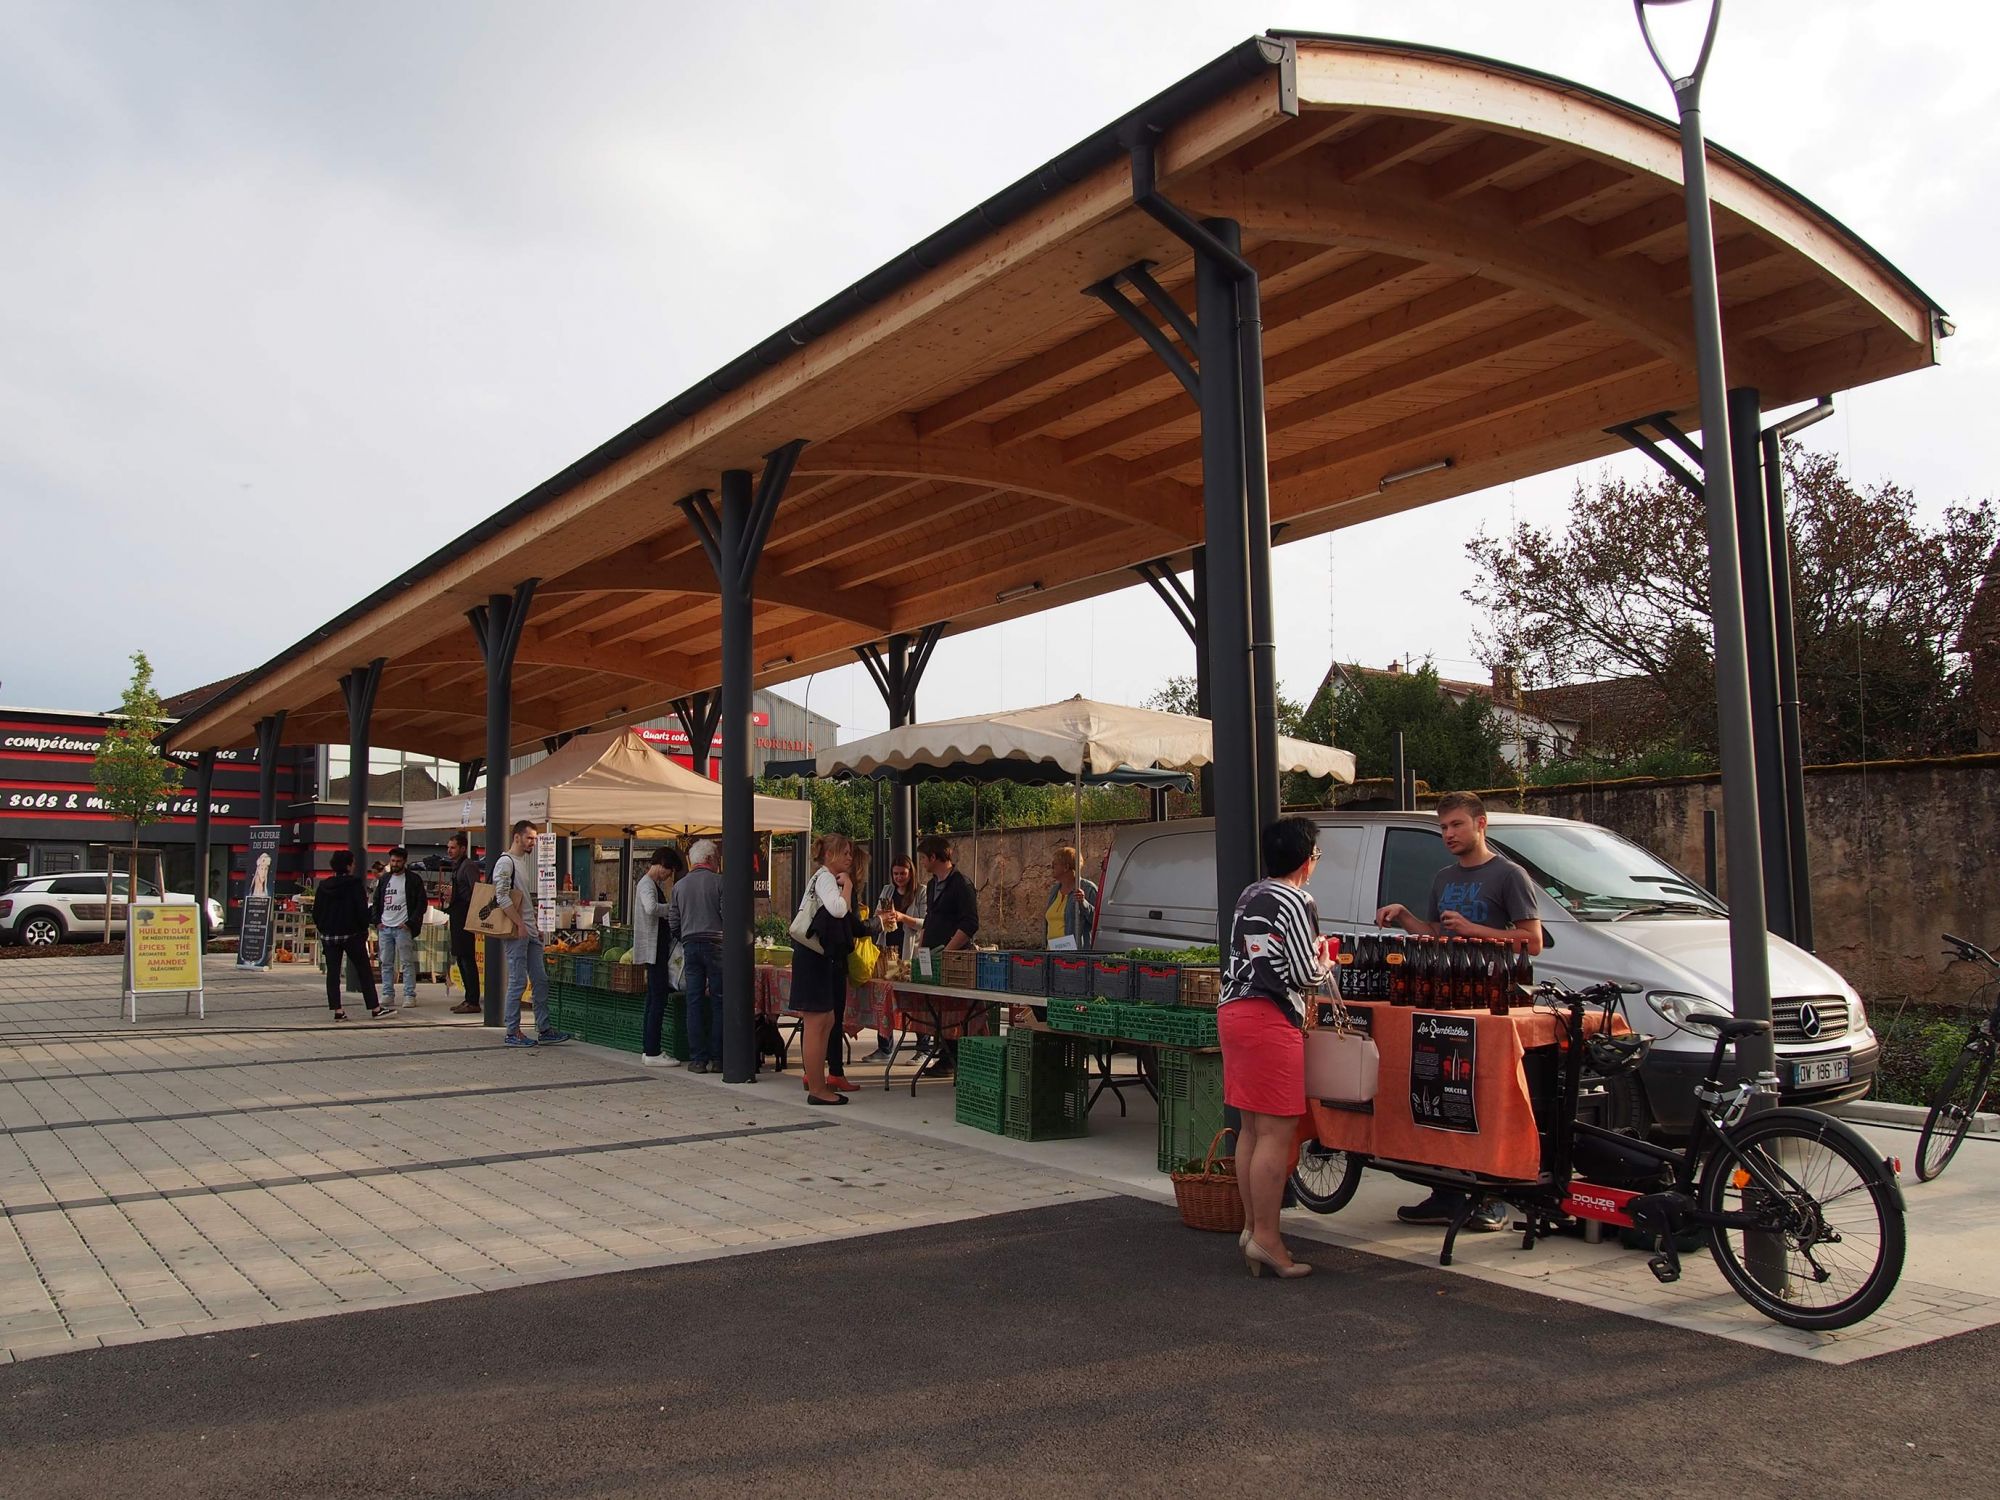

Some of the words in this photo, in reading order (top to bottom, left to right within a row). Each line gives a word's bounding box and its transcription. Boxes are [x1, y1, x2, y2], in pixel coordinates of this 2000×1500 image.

[643, 730, 670, 740] Quartz
[4, 736, 101, 752] compétence
[9, 793, 58, 808] sols
[65, 793, 78, 808] &
[138, 927, 162, 935] HUILE
[163, 927, 195, 935] D'OLIVE
[147, 958, 187, 966] AMANDES
[1572, 1193, 1616, 1208] DOUZE
